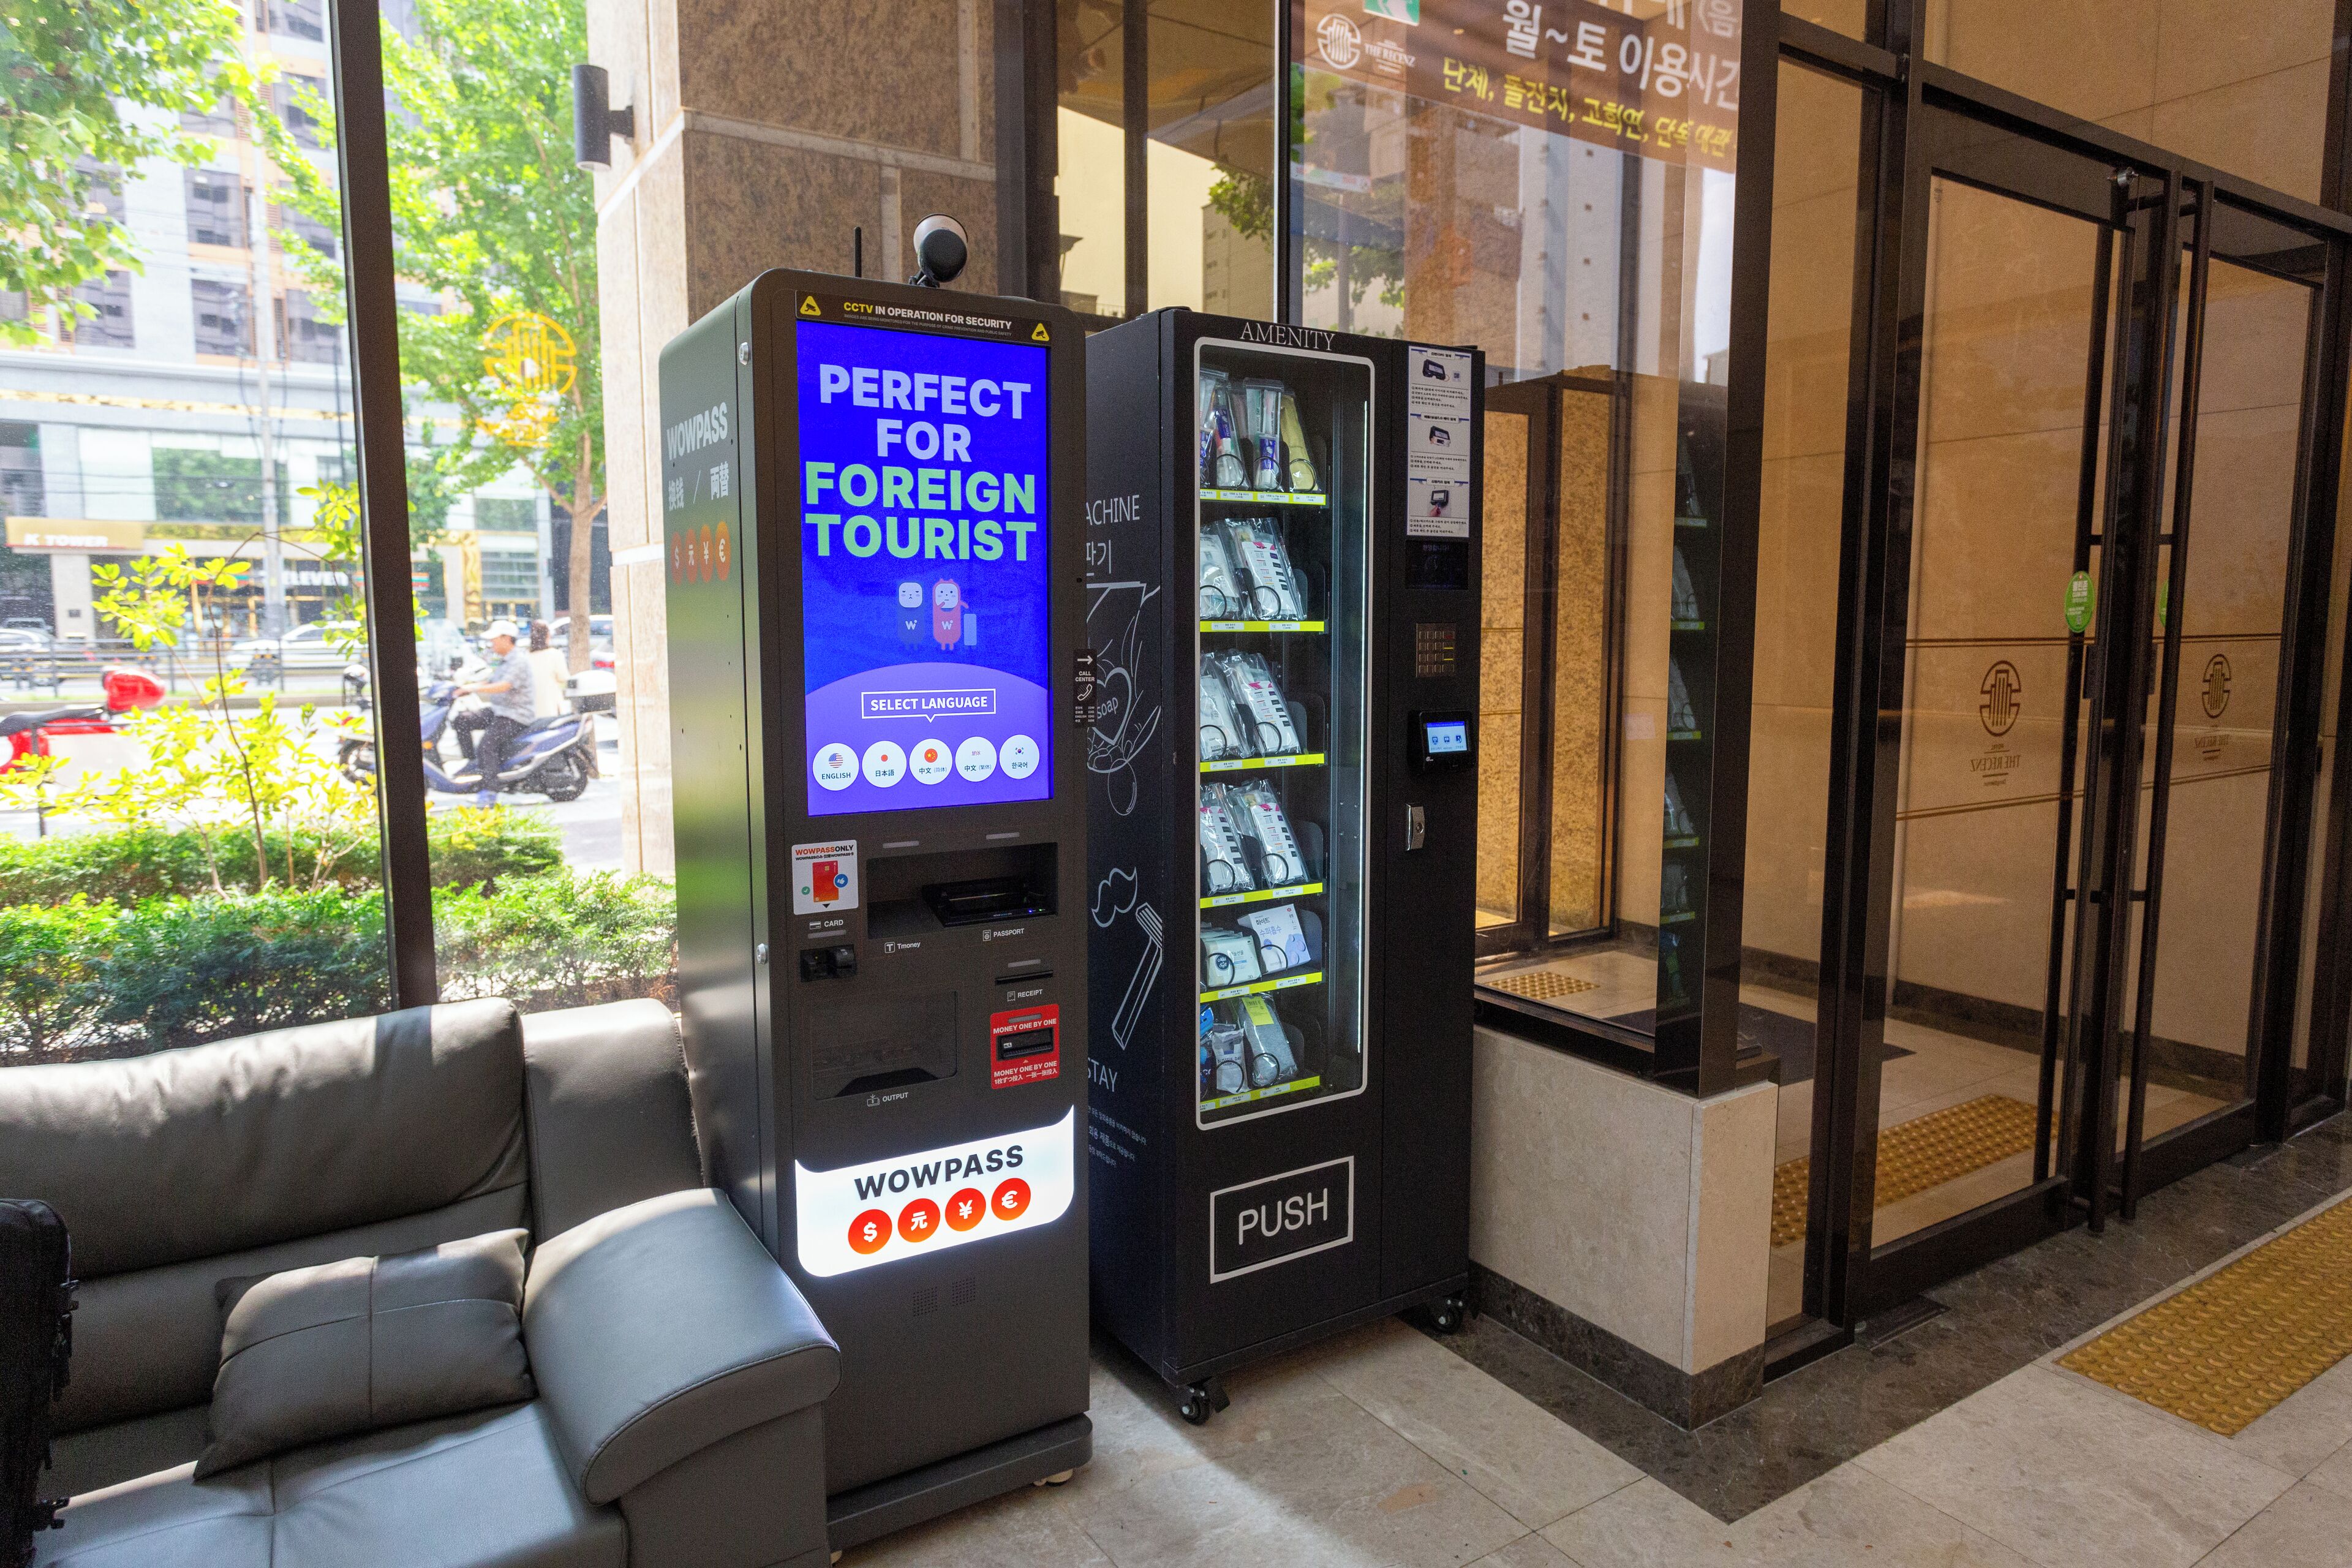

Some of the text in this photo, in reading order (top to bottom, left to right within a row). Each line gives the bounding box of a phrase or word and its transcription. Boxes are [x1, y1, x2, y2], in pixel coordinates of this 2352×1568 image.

[843, 302, 1012, 330] CCTV IN OPERATION FOR SECURITY
[1239, 322, 1335, 351] AMENITY
[820, 364, 1031, 420] PERFECT
[666, 402, 728, 460] WOWPASS
[876, 419, 971, 462] FOR
[805, 462, 1035, 514] FOREIGN
[24, 533, 108, 547] K TOWER
[805, 513, 1036, 561] TOURIST
[870, 696, 987, 711] SELECT LANGUAGE
[1097, 697, 1118, 719] soap
[796, 845, 854, 856] WOWPASSONLY
[824, 919, 843, 928] CARD
[993, 929, 1025, 938] PASSPORT
[897, 941, 921, 951] Tmoney
[1017, 989, 1043, 998] RECEIPT
[993, 1025, 1017, 1034] MONEY
[994, 1068, 1018, 1077] MONEY
[995, 1074, 1023, 1085] 1枚ずつ投入
[883, 1093, 908, 1102] OUTPUT
[854, 1145, 1023, 1200] WOWPASS
[863, 1190, 1018, 1242] $ 元 ¥ €
[1238, 1188, 1327, 1245] PUSH
